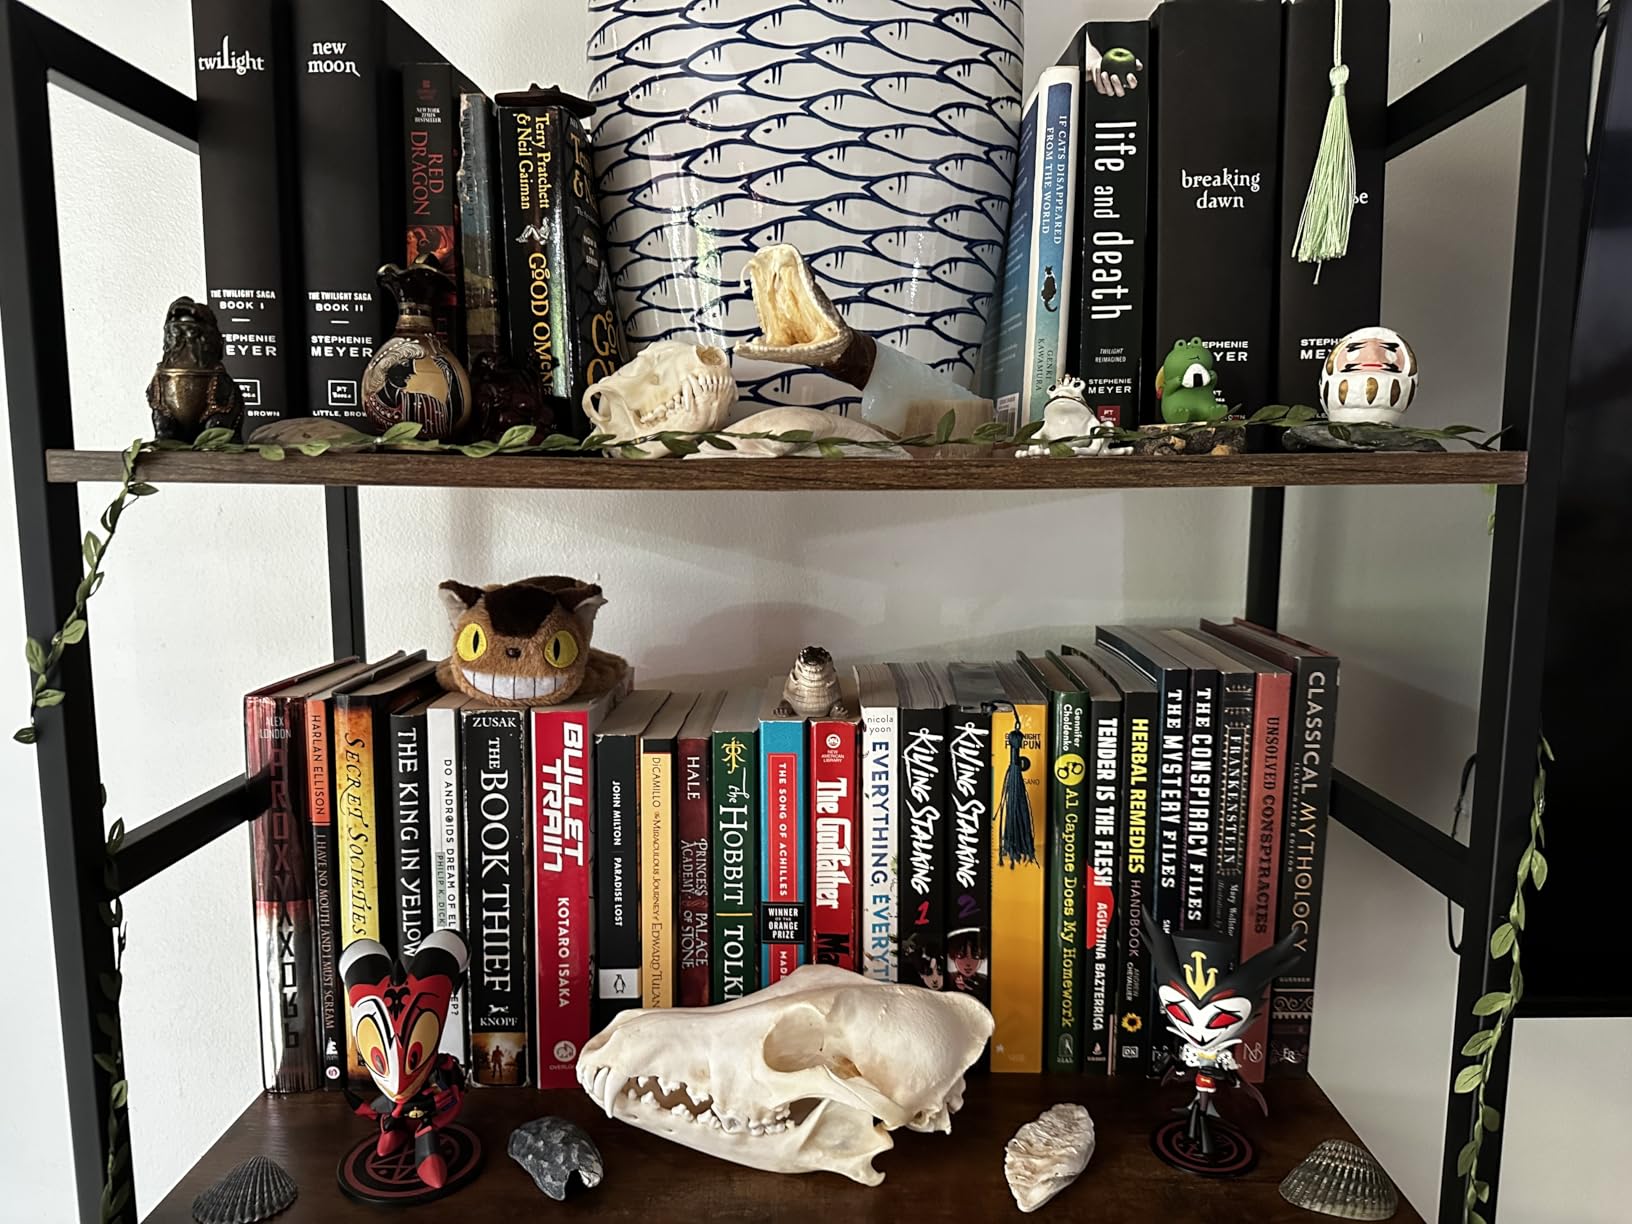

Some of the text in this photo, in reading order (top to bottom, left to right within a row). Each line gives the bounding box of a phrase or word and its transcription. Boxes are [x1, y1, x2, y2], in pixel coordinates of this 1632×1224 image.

[199, 35, 264, 75] twilight
[308, 60, 360, 77] moon
[312, 41, 347, 55] new
[411, 131, 430, 215] DRAGON
[428, 153, 444, 193] RED
[516, 113, 534, 210] & Neil Gaiman
[535, 113, 552, 209] Terry Pratchett
[1041, 127, 1054, 234] FROM THE WORLD
[1053, 115, 1067, 245] IF CATS DISAPPEARED
[1181, 168, 1261, 192] breaking
[1091, 122, 1137, 319] life and death
[1196, 190, 1244, 209] dawn
[210, 290, 276, 299] THE TWILIGHT SAGA
[220, 301, 254, 310] BOOK
[308, 292, 372, 301] THE TWILIGHT SAGA
[529, 253, 550, 316] GOOD
[315, 303, 349, 312] BOOK
[226, 345, 277, 356] EYER
[311, 335, 373, 344] STEPHENIE
[311, 345, 373, 357] MEYER
[1213, 352, 1248, 361] YER
[1036, 338, 1045, 391] KAWAMURA
[1088, 386, 1132, 394] MEYER
[260, 728, 292, 739] LONDON
[264, 716, 284, 727] ALEX
[473, 717, 517, 728] ZUSAK
[867, 715, 893, 723] nicola
[869, 726, 892, 735] yoon
[1063, 704, 1072, 751] Choldenko
[1074, 708, 1083, 747] Gennifer
[311, 715, 325, 816] HARLAN ELLISON
[444, 759, 453, 776] DO
[686, 756, 700, 800] HALE
[563, 722, 584, 867] BULLET
[816, 777, 848, 814] The
[1093, 718, 1118, 886] TENDER IS THE FLESH
[1128, 718, 1149, 874] HERBAL REMEDIES
[1161, 689, 1184, 887] THE MYSTERY FILES
[1187, 688, 1213, 920] THE CONSPIRACY FILES
[1224, 735, 1242, 863] FRANKENSTEIN
[1290, 762, 1300, 828] ILLUSTRATED
[445, 781, 454, 843] ANDROIDS
[779, 763, 788, 896] THE SONG OF ACHILLES
[1255, 717, 1280, 934] UNSOLVED CONSPIRACIES
[1290, 671, 1326, 951] CLASSICAL MYTHOLOGY
[316, 841, 327, 868] HAVE
[339, 733, 372, 936] SECRET SOCIETIES
[397, 728, 422, 957] THE KING IN YELLOW
[612, 781, 623, 927] JOHN MILTON PARADISE LOST
[652, 819, 661, 875] MIRACULOUS
[719, 805, 748, 905] HOBBIT
[317, 869, 328, 886] NO
[446, 849, 456, 889] DREAM
[480, 737, 511, 992] THE BOOK THIEF
[816, 817, 851, 909] Godfather
[318, 889, 330, 927] MOUTH
[448, 894, 456, 909] OF
[683, 910, 692, 923] OF
[695, 838, 709, 967] PRINCESS PALACE
[768, 908, 799, 917] WINNER
[914, 901, 929, 925] 1
[958, 895, 980, 918] 2
[1060, 788, 1079, 1027] Al Capone Does My Homework
[1129, 880, 1141, 957] HANDBOOK
[320, 930, 331, 953] AND
[651, 923, 663, 970] EDWARD
[681, 924, 695, 969] STONE
[768, 922, 799, 931] ORANGE
[772, 931, 795, 939] PRIZE
[871, 894, 890, 983] EVERYT
[322, 960, 333, 986] MUST
[557, 897, 571, 1008] KOTARO ISAKA
[724, 925, 744, 1000] TOLKI
[1093, 902, 1108, 1031] AGUSTINA BAZTERRICA
[324, 988, 335, 1029] SCREAM
[480, 1017, 518, 1027] KNOPF
